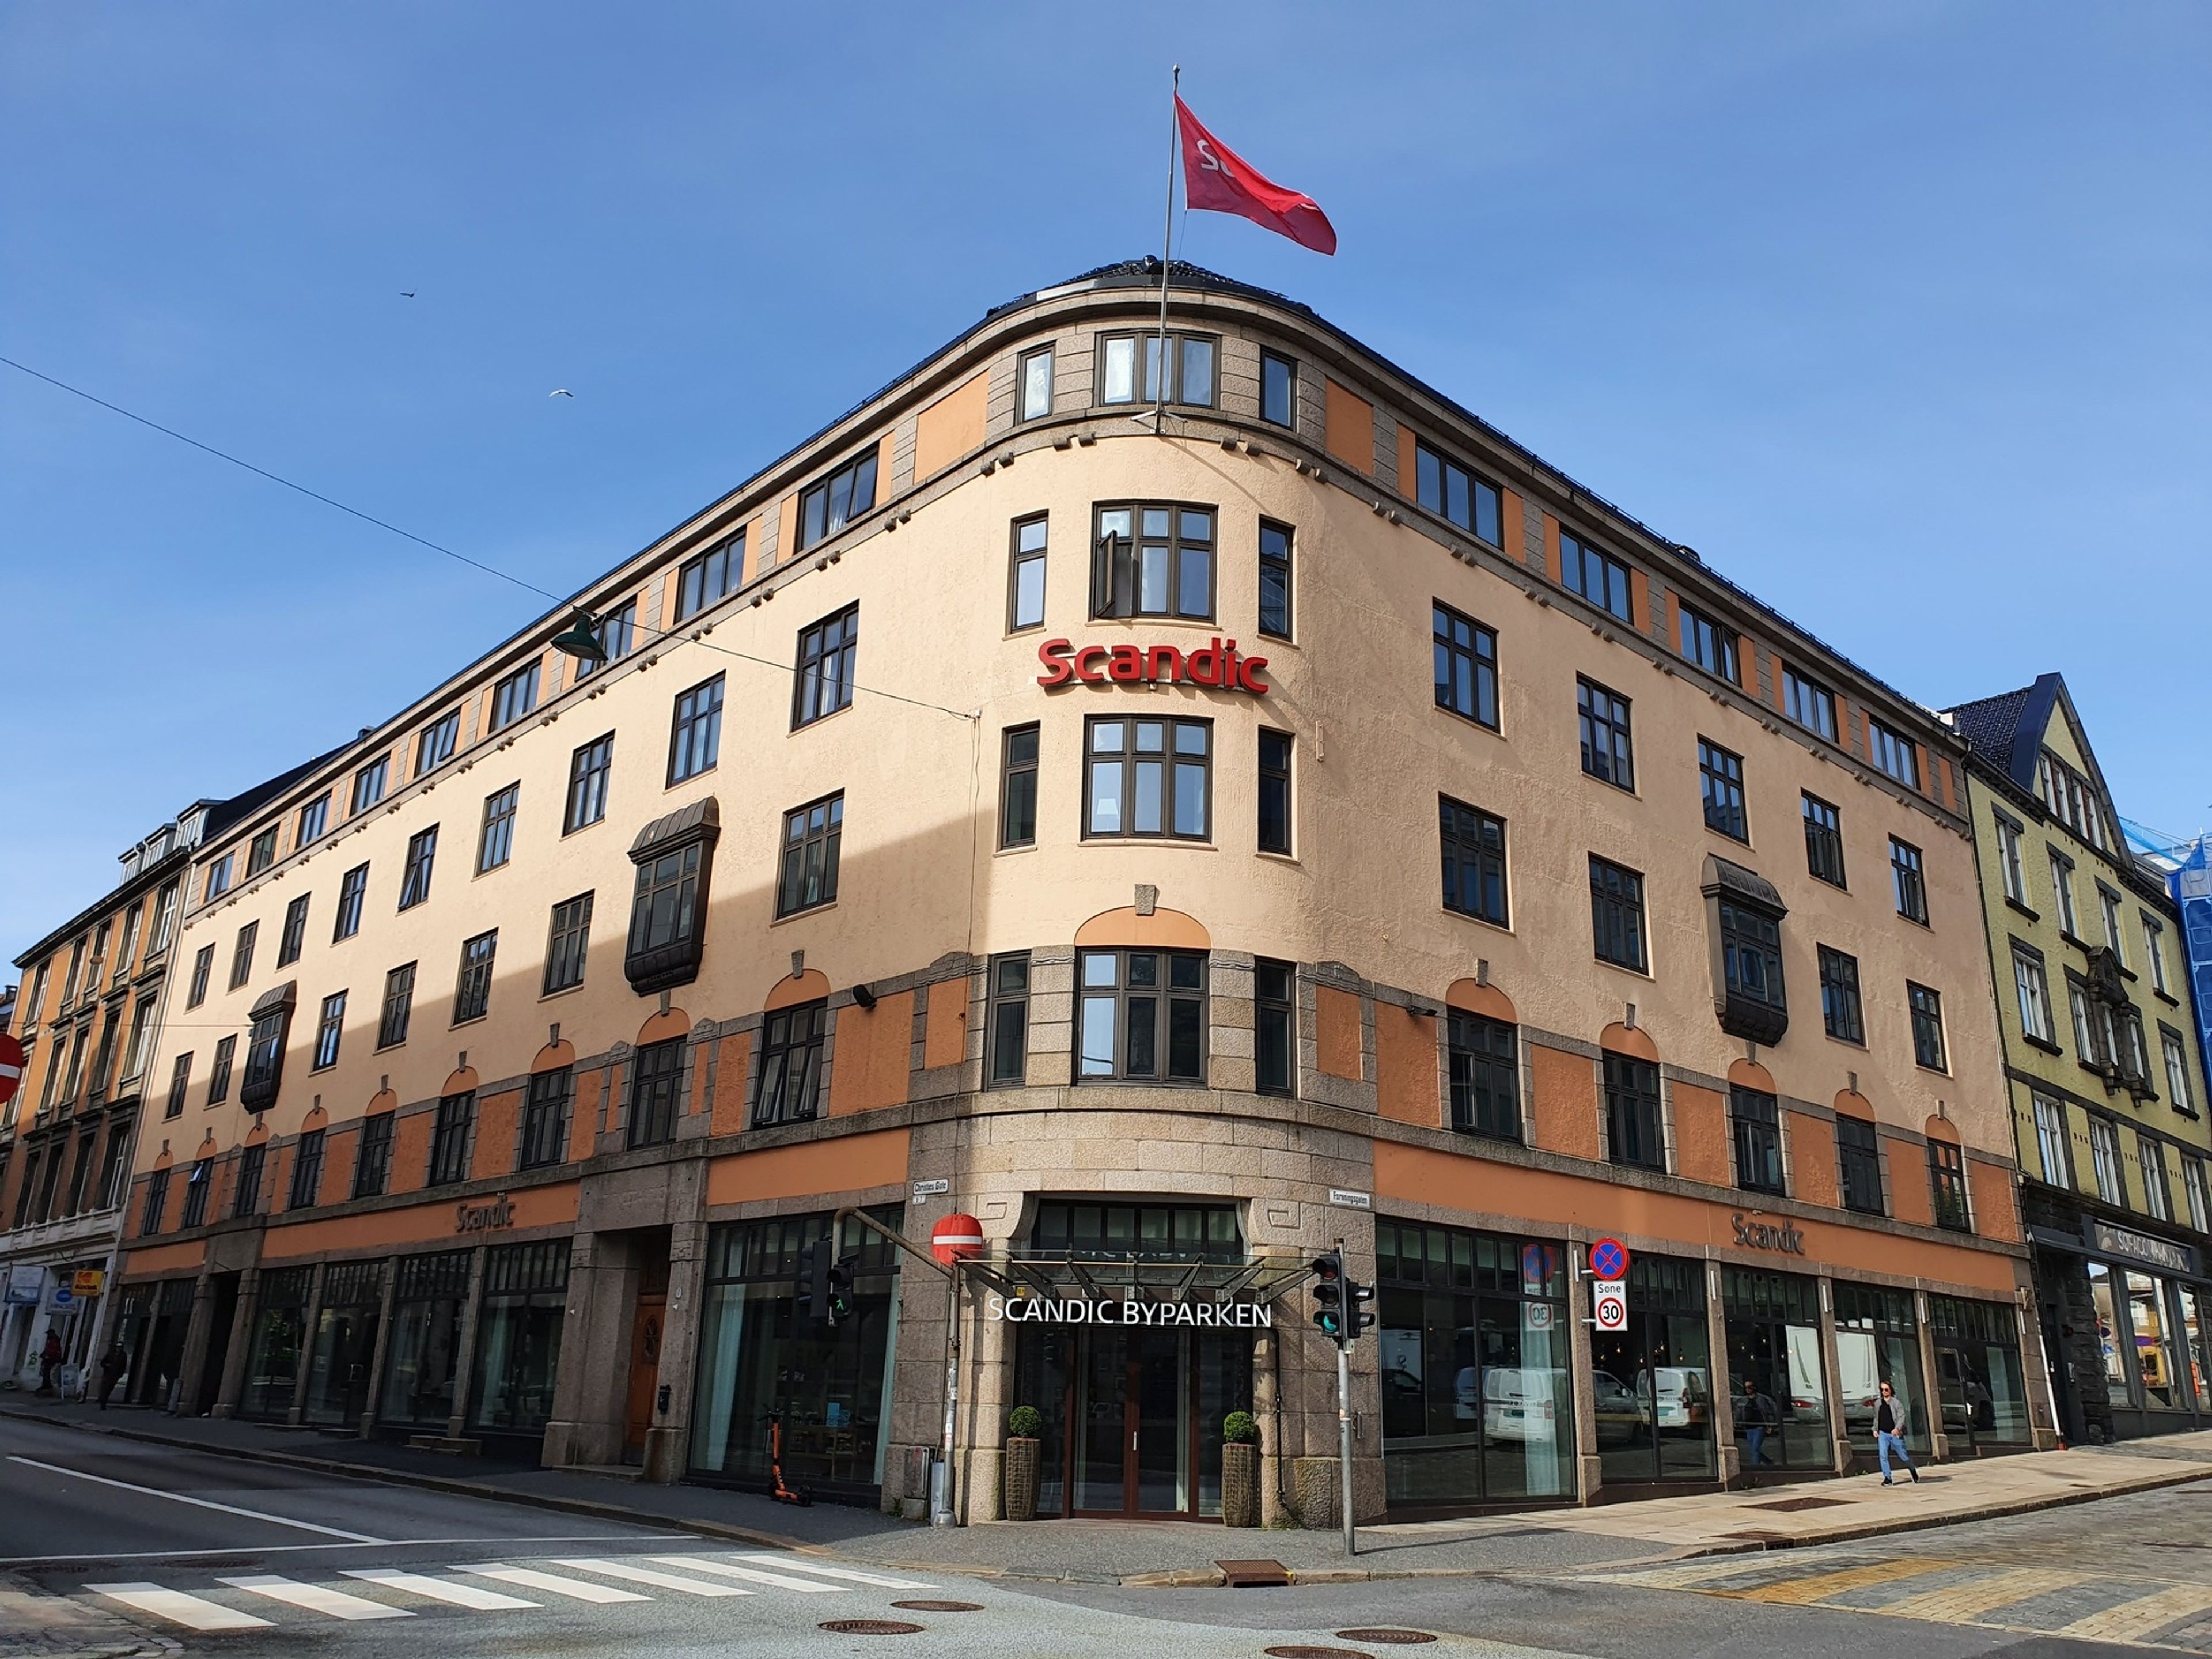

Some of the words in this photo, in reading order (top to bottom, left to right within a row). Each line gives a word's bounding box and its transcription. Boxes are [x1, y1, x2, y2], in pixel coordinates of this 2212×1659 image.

[1037, 637, 1268, 695] Scandic
[455, 1195, 516, 1232] Scandic
[1732, 1213, 1805, 1255] Scandic
[1598, 1283, 1622, 1294] Sone
[988, 1297, 1113, 1324] SCANDIC
[1123, 1301, 1272, 1327] BYPARKEN
[1602, 1305, 1619, 1320] 30
